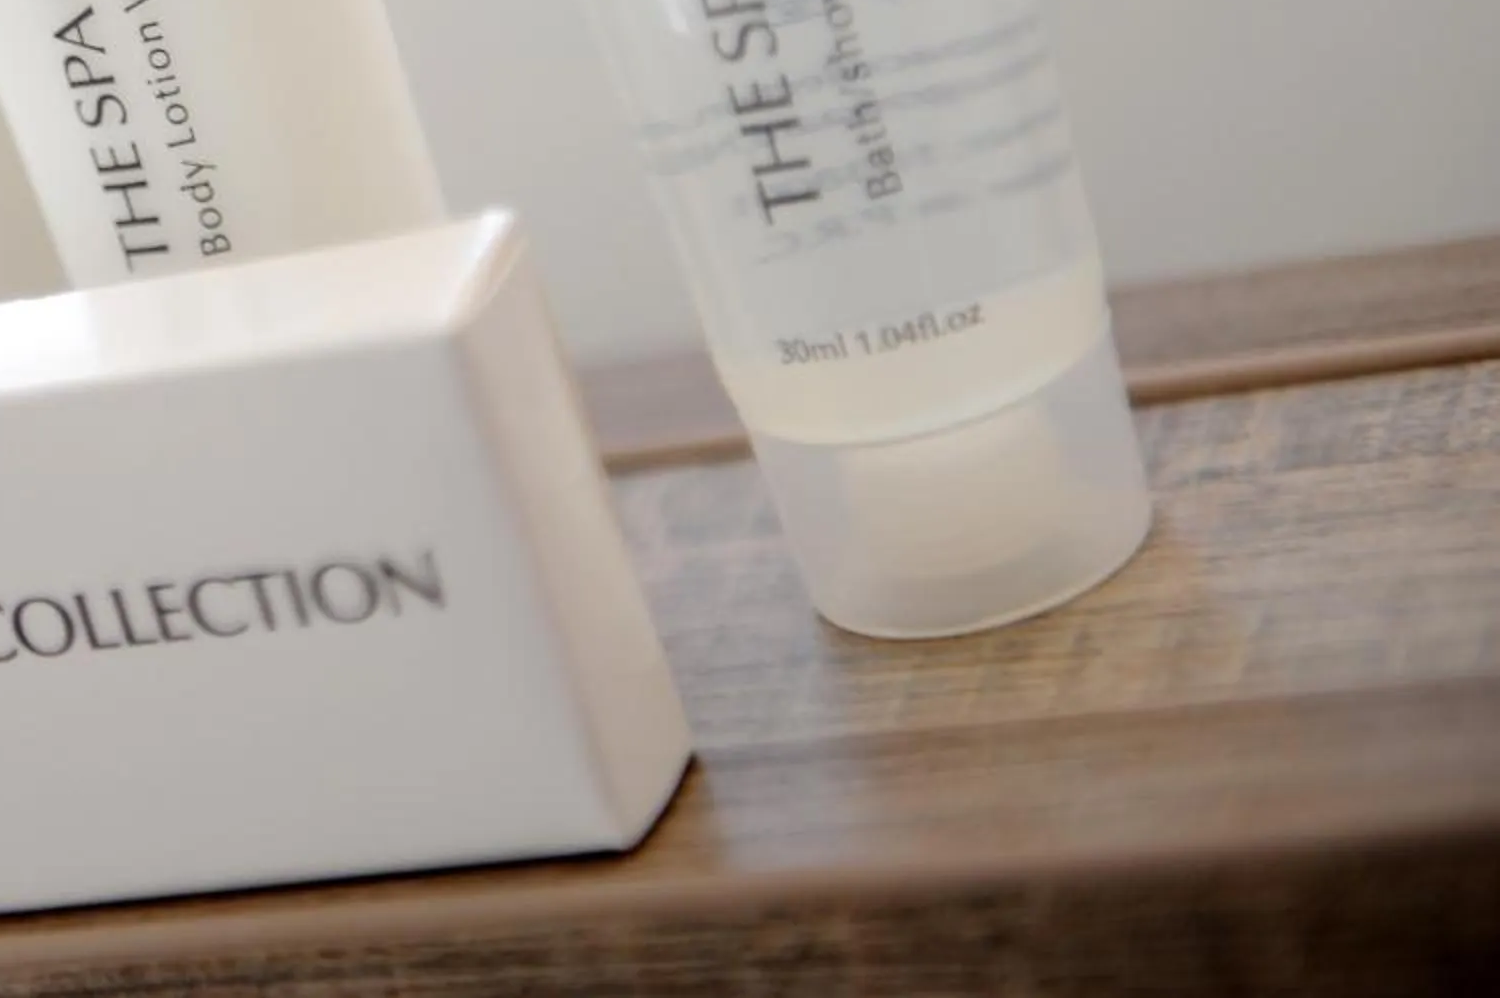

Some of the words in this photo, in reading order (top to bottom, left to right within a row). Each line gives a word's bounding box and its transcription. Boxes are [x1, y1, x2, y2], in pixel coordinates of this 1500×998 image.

[54, 6, 130, 129] SPA
[138, 21, 196, 148] Lotion
[90, 142, 170, 273] THE
[180, 159, 231, 258] Body
[728, 75, 821, 226] THE
